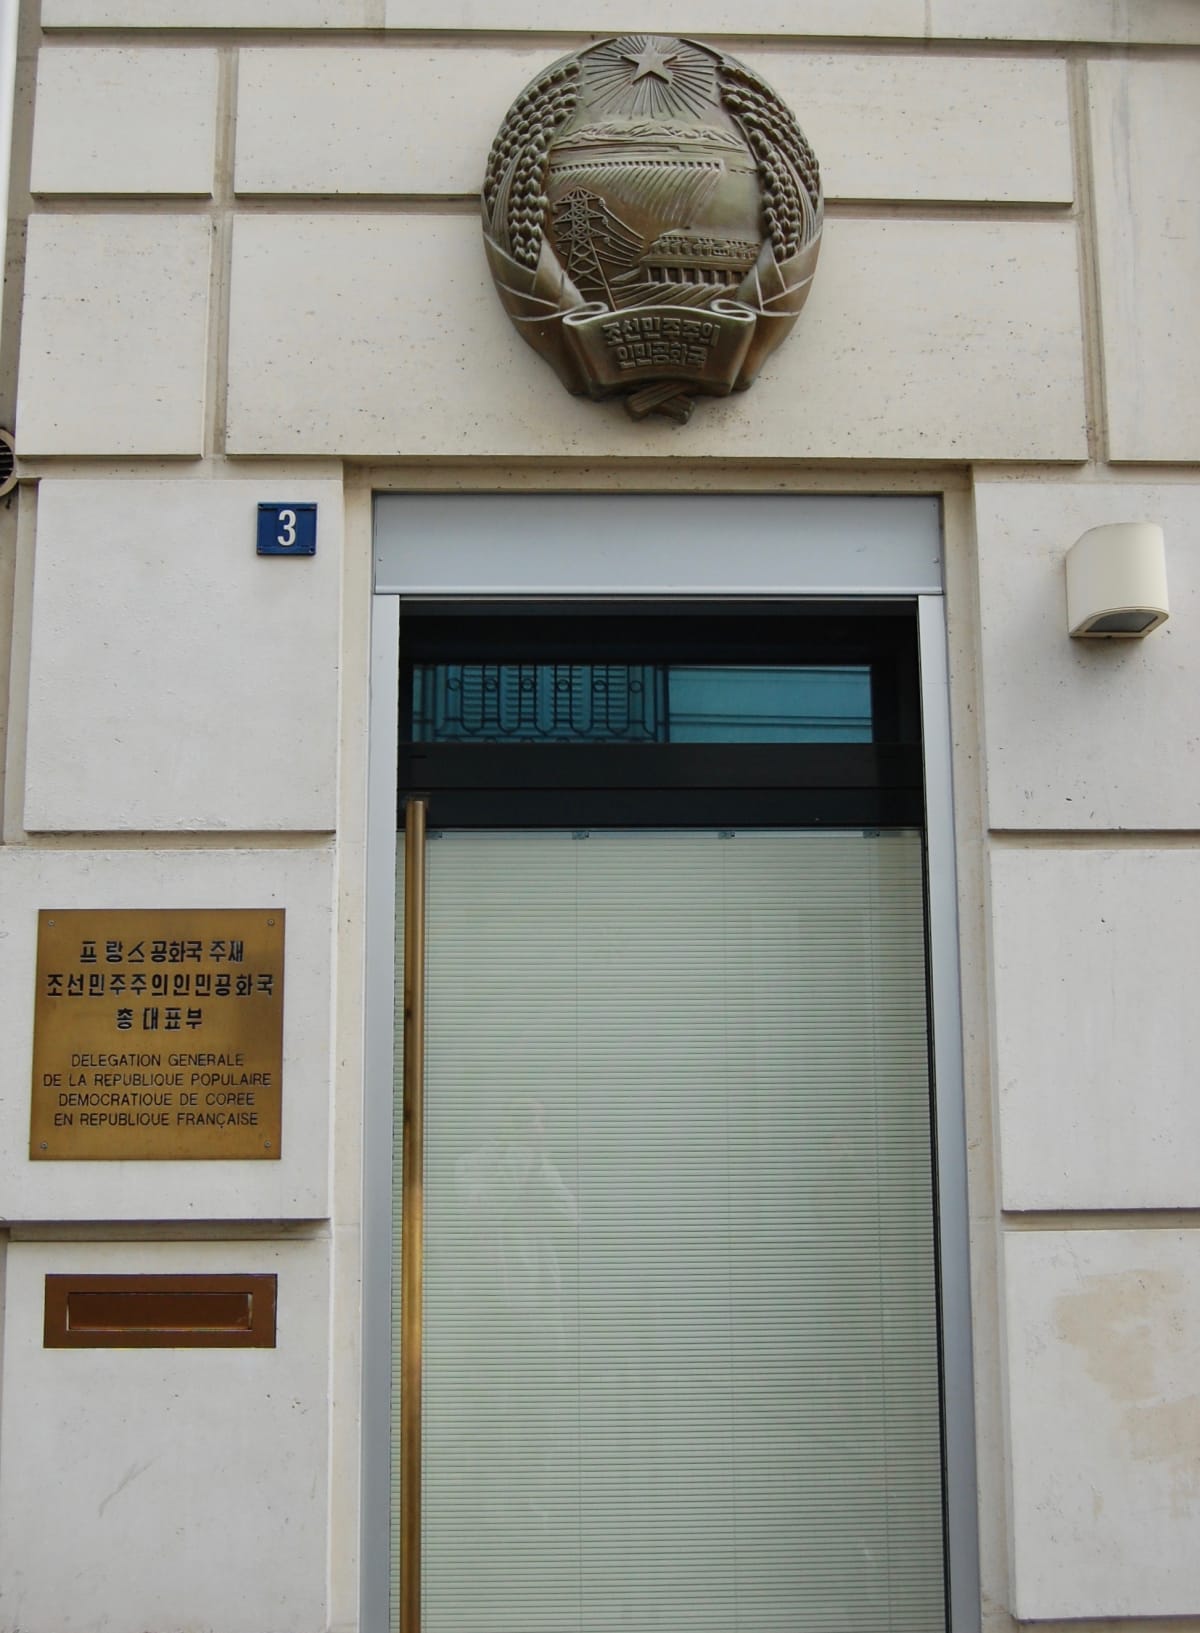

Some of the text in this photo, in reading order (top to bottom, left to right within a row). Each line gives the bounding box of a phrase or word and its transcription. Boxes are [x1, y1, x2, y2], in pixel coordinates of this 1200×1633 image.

[602, 317, 721, 347] 조선민주주의
[617, 341, 708, 369] 인민공화국
[277, 509, 297, 546] 3
[71, 1053, 245, 1067] DELEGATION GENERALE
[43, 1073, 272, 1087] DE LA REPUBLIQUE POPULAIRE
[58, 1093, 256, 1107] DEMOCRATIQUE DE COREE
[53, 1112, 259, 1129] EN REPUBLIQUE FRANÇAISE
